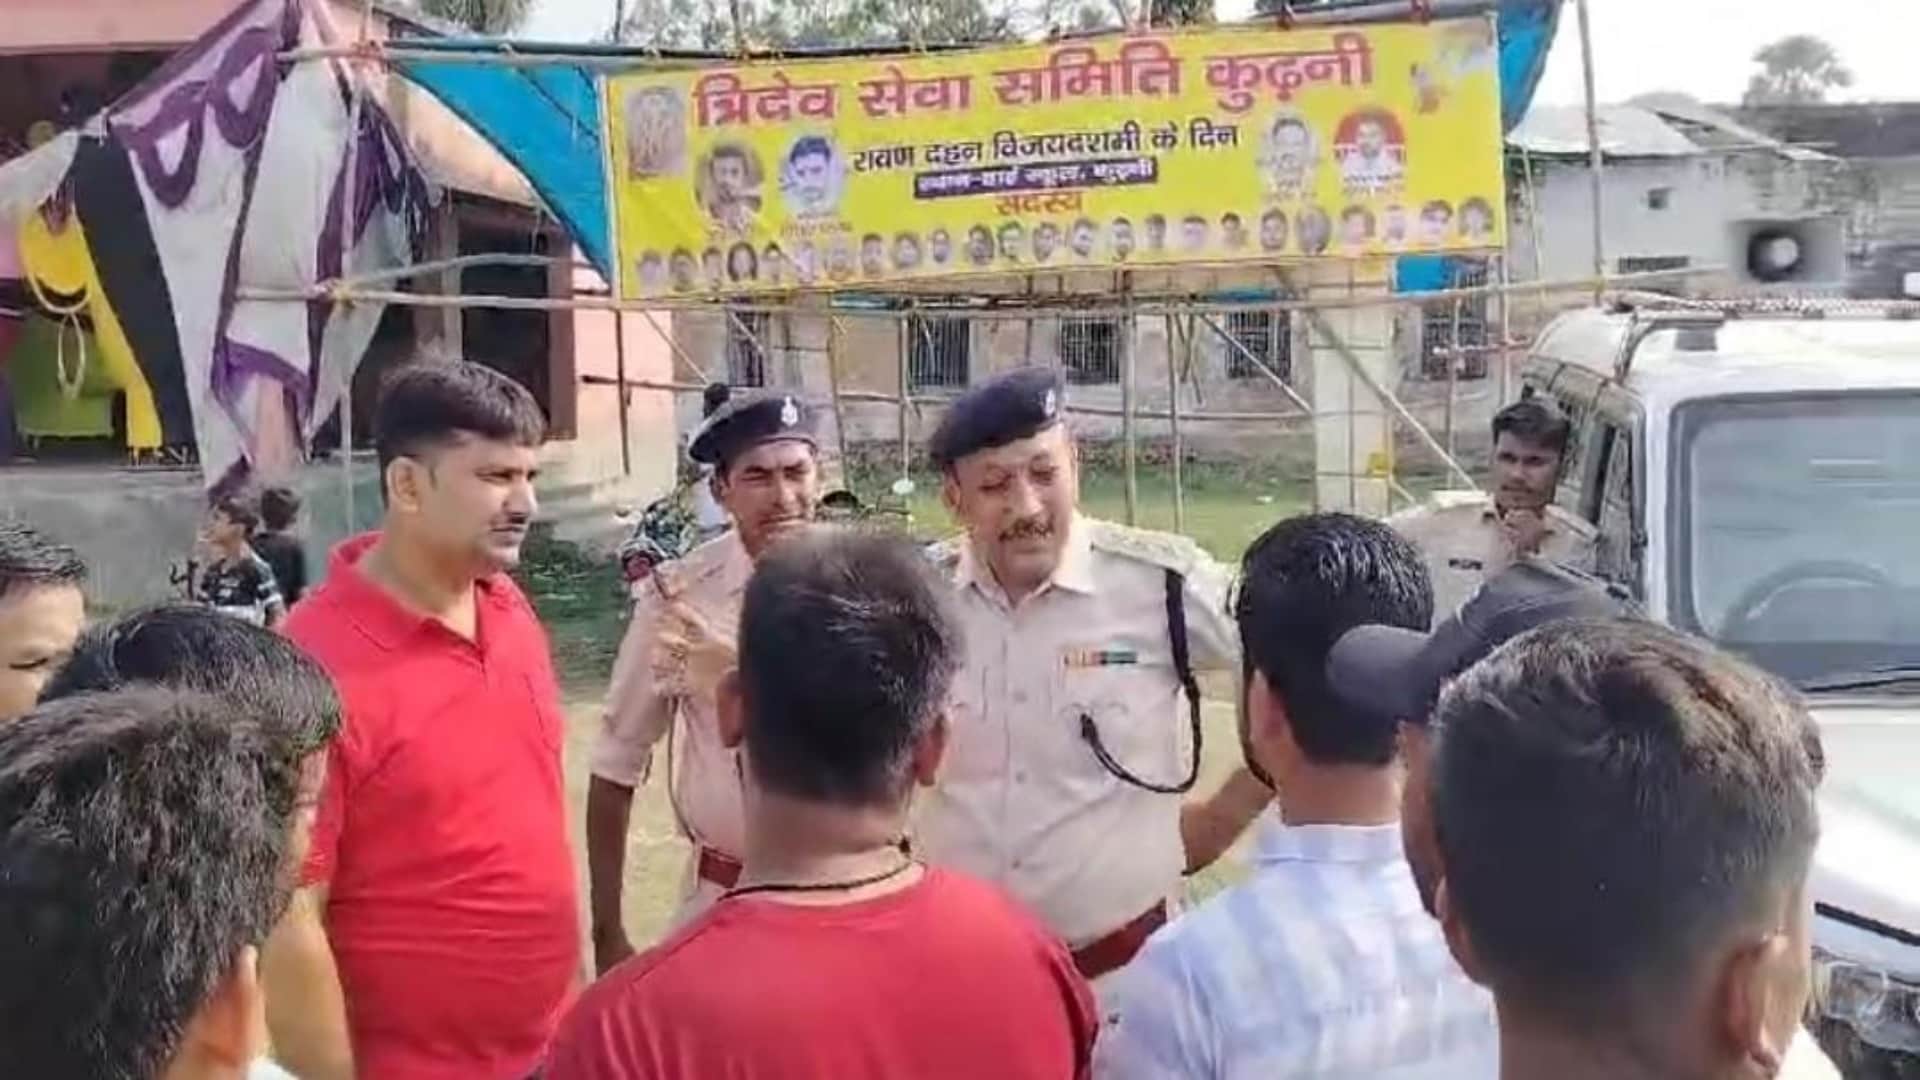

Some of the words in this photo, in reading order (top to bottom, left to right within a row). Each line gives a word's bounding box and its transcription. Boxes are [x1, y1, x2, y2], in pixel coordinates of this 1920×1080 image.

[693, 70, 838, 127] त्रिदेव
[858, 65, 972, 118] सेवा
[993, 39, 1184, 106] समिति
[1203, 33, 1373, 112] कुढ़नी
[853, 144, 915, 173] रावण
[925, 139, 983, 166] दहन
[993, 120, 1141, 162] विजयदशमी
[1150, 121, 1178, 150] के
[1190, 117, 1239, 149] दिन
[996, 191, 1083, 216] सदस्य
